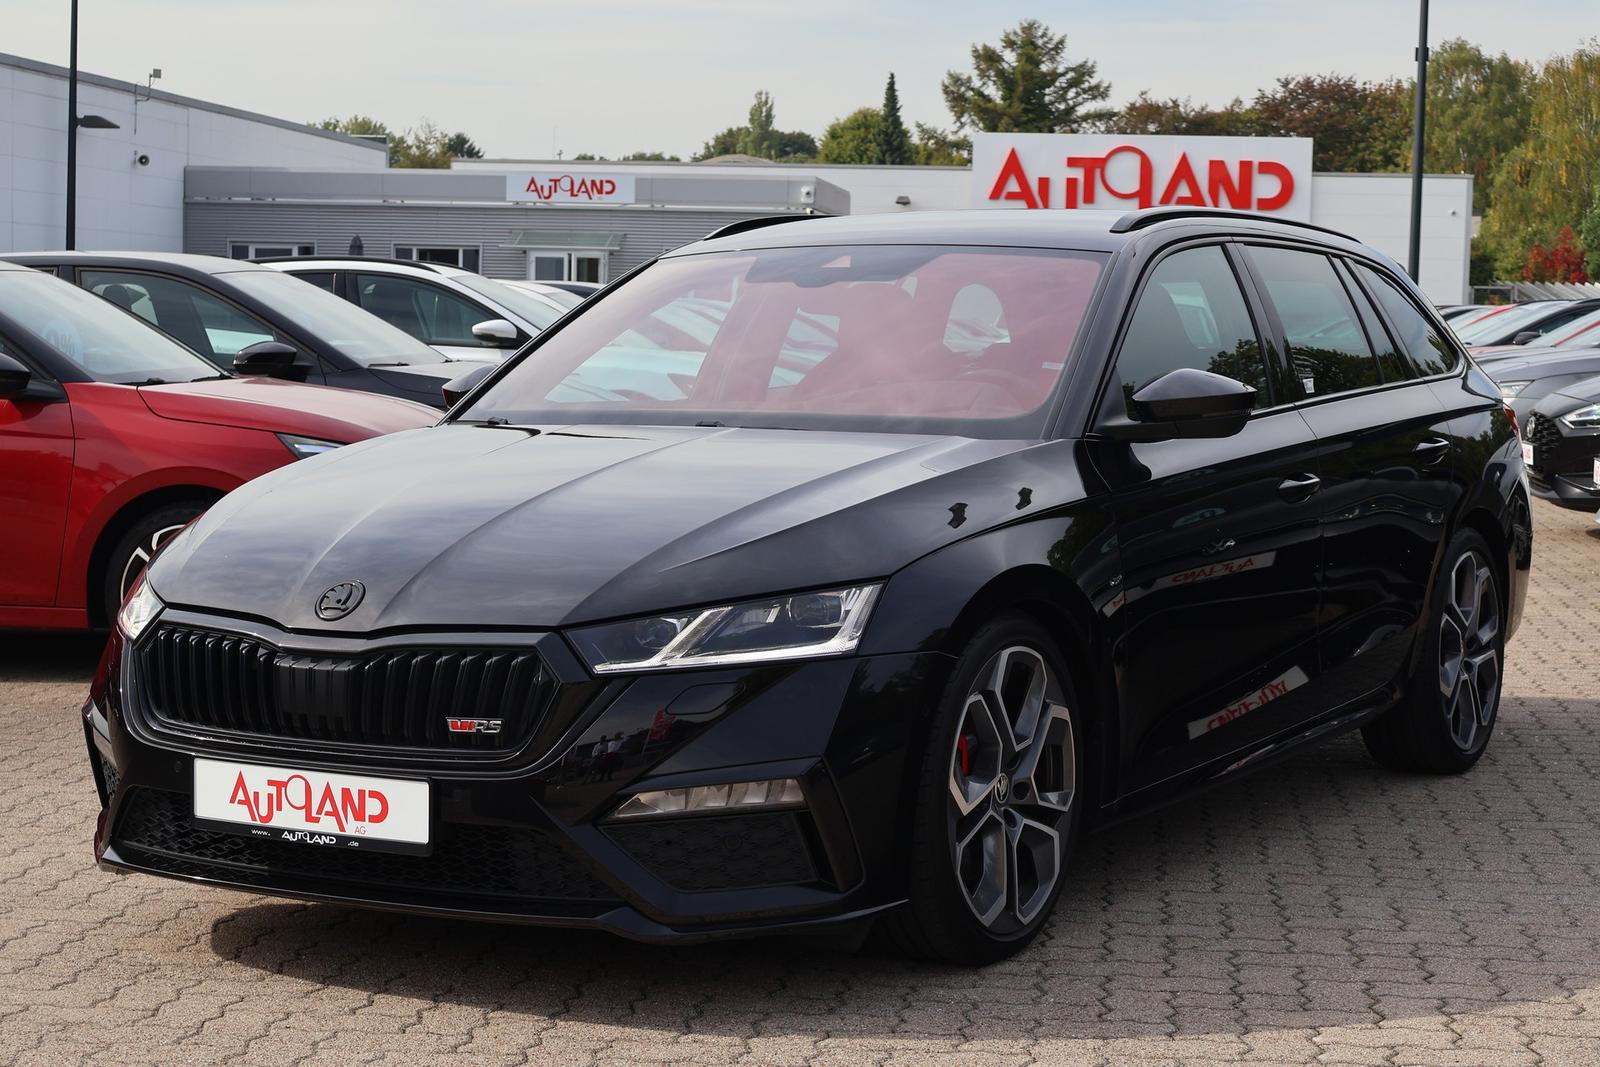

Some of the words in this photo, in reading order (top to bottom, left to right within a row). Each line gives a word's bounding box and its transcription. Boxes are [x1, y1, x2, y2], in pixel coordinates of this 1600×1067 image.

[526, 175, 617, 200] AUTOLAND
[229, 770, 389, 832] AUTOLAND
[251, 829, 271, 837] www.
[281, 831, 337, 845] AUTOLAND
[355, 826, 366, 835] AG
